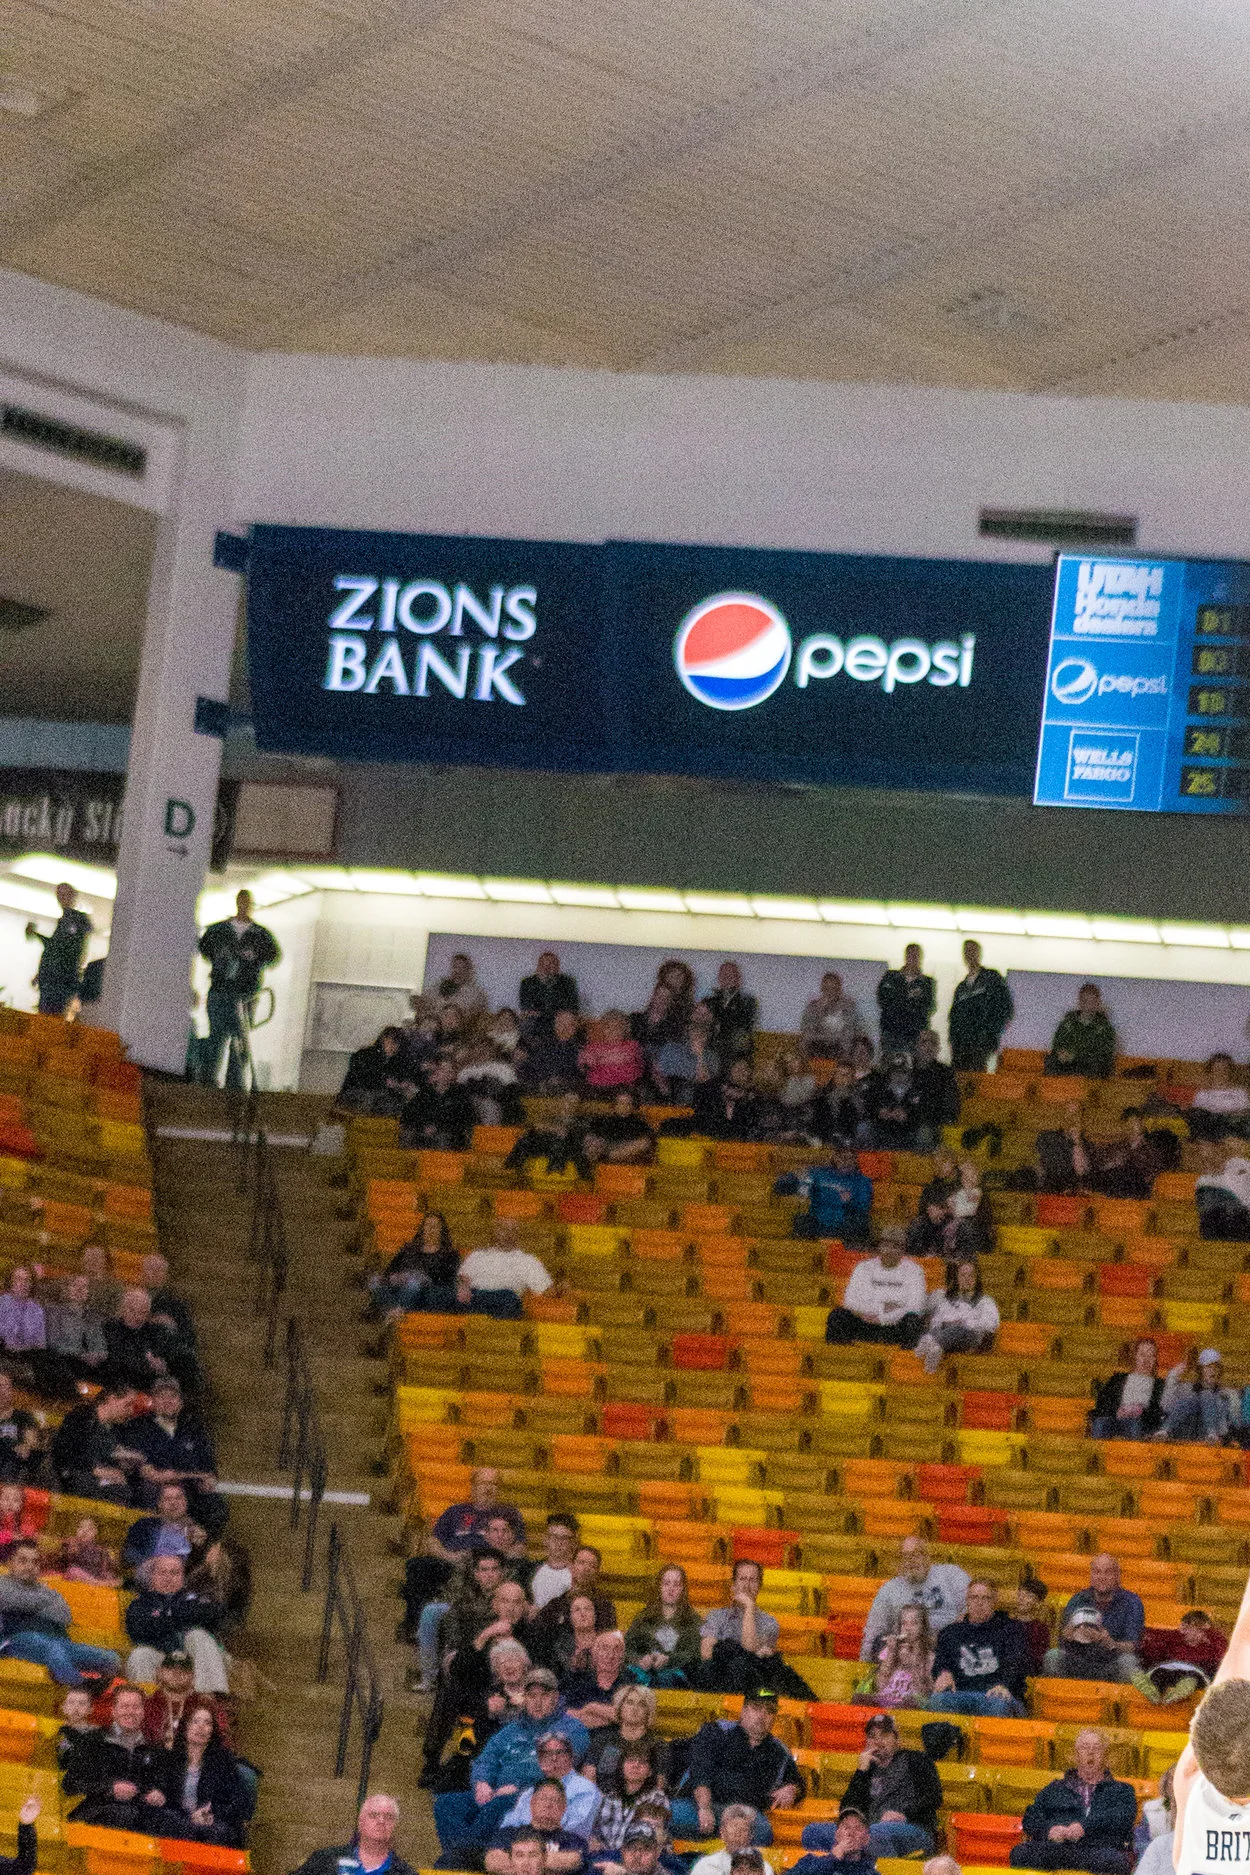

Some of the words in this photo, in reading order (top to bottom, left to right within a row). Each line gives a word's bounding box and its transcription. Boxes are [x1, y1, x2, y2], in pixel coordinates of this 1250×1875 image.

[328, 574, 538, 641] ZIONS
[324, 632, 527, 706] BANK
[794, 632, 976, 694] pepsi
[1097, 674, 1169, 698] pepsi
[1072, 747, 1132, 766] WELLS
[164, 798, 195, 838] D
